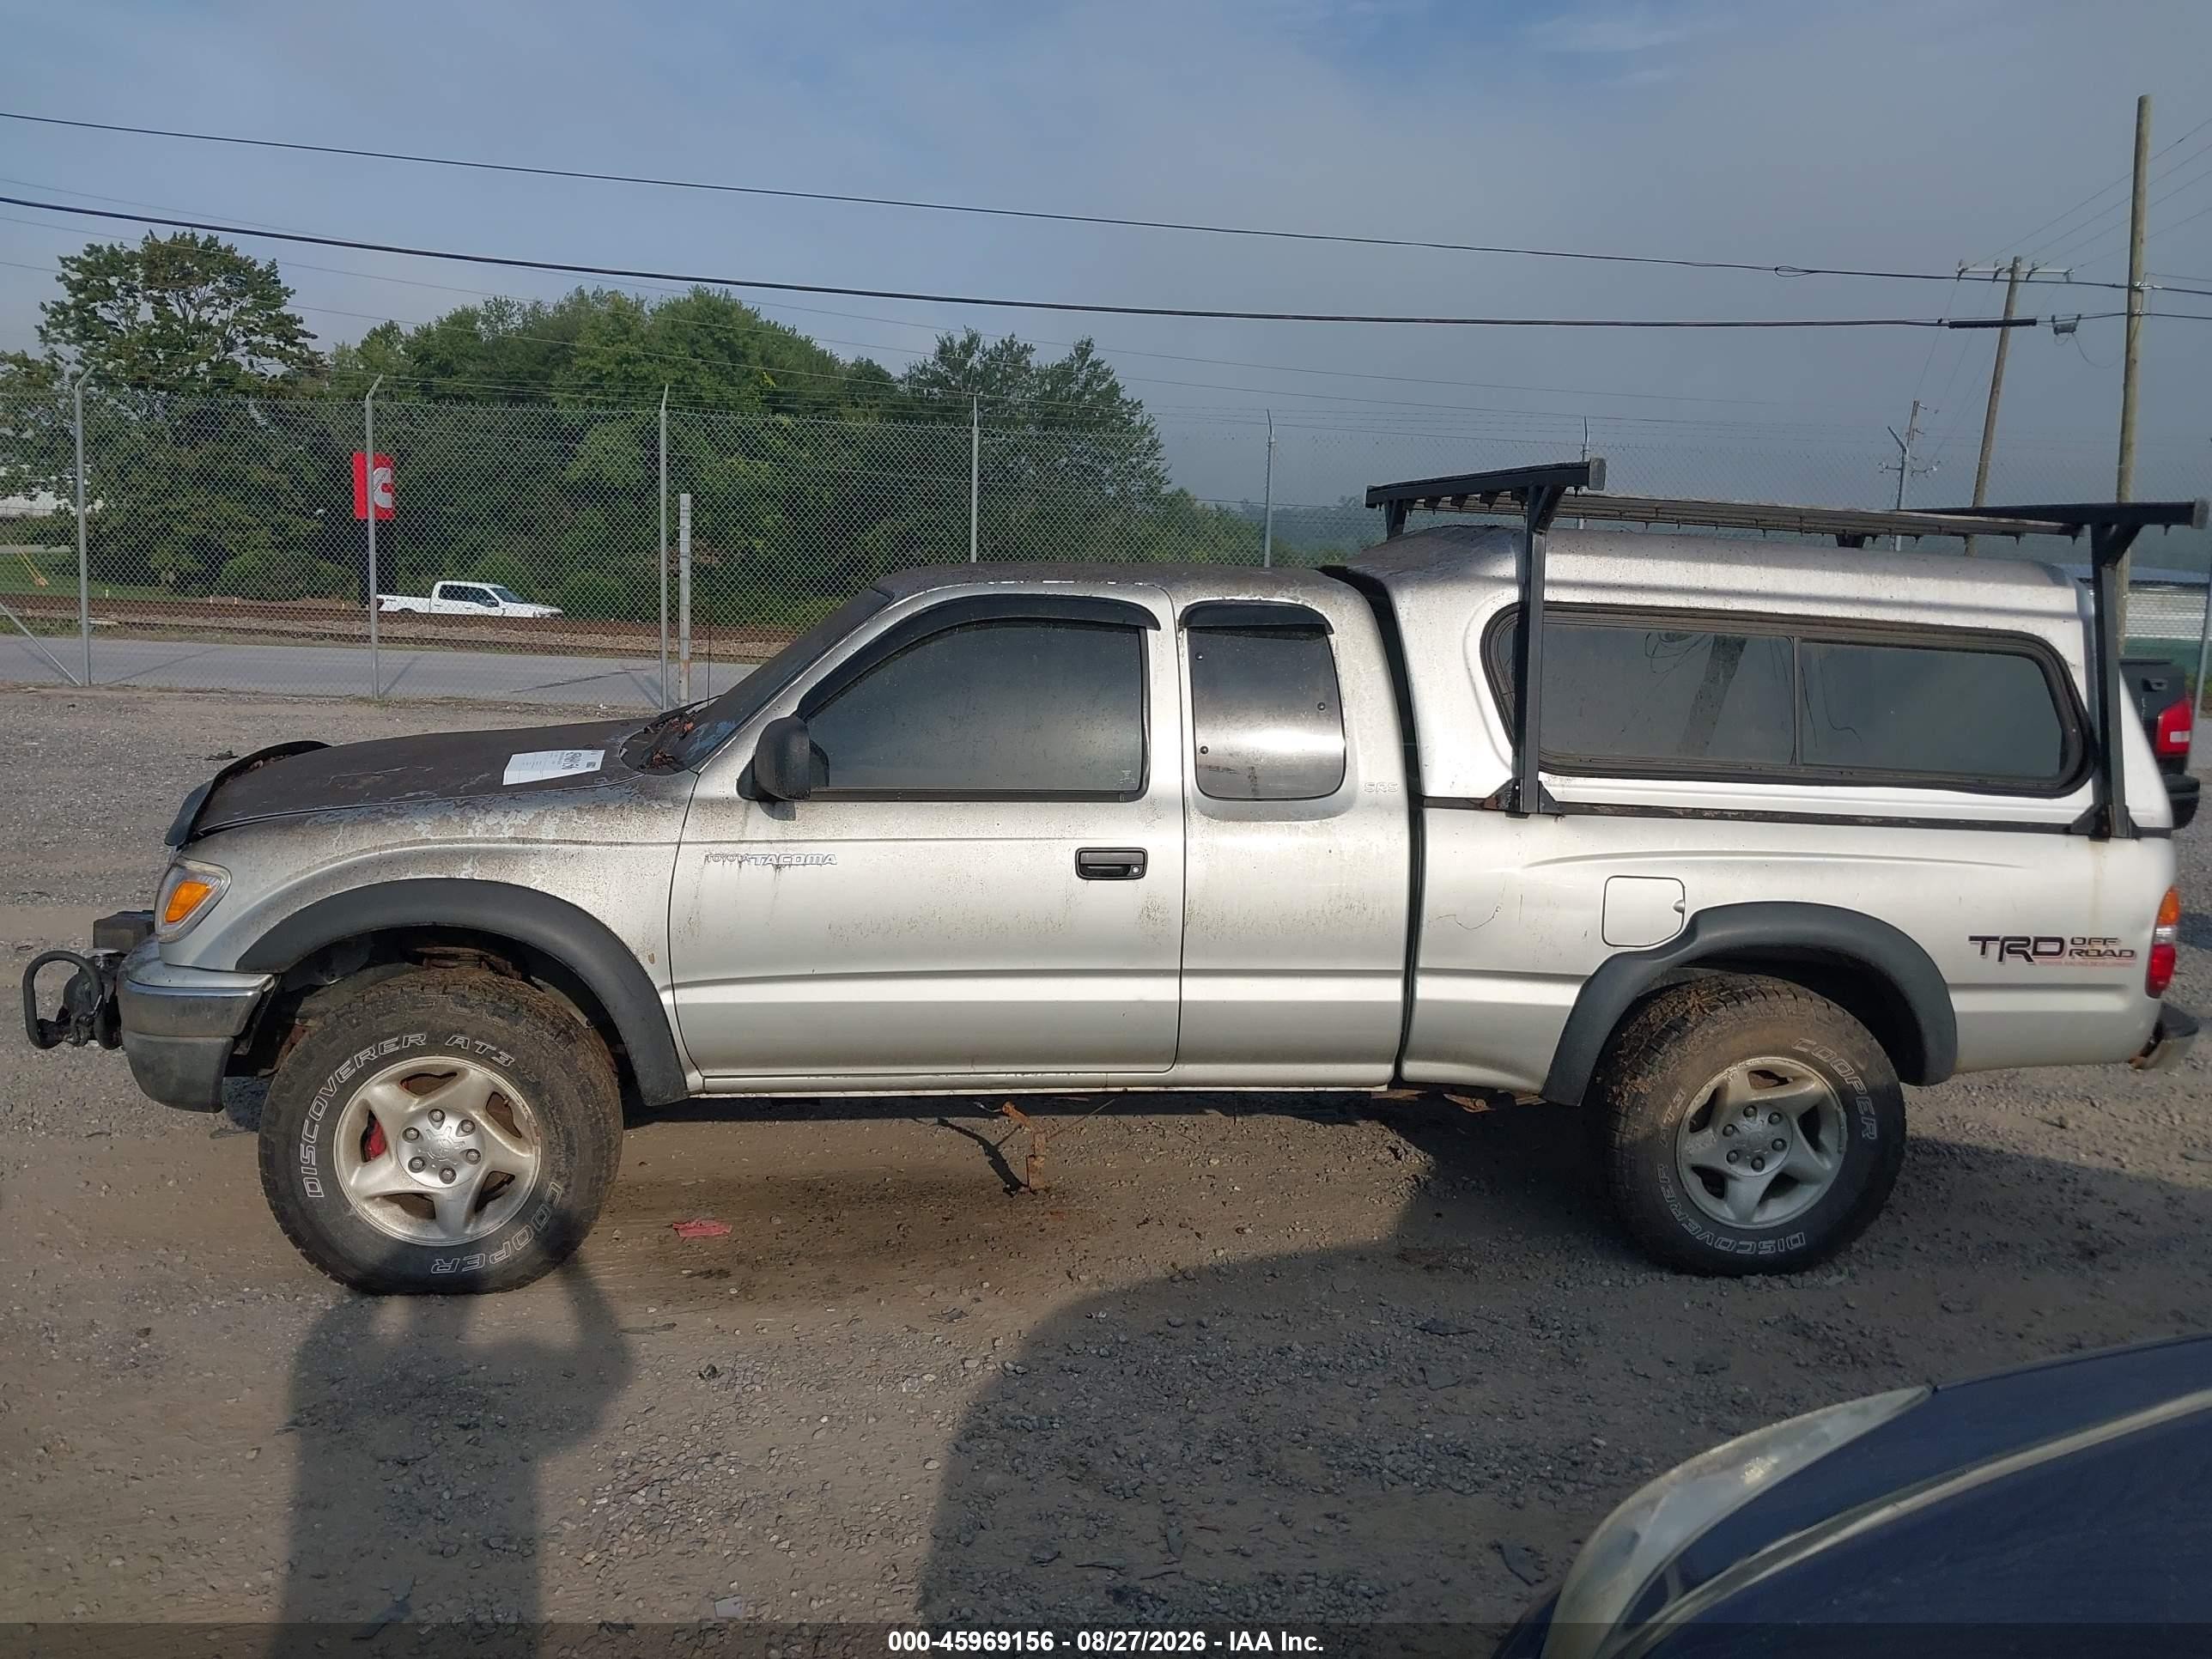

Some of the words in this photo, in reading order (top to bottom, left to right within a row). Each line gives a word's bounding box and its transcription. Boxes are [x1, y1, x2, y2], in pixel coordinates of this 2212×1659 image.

[1364, 781, 1399, 793] SRS
[705, 854, 750, 863] TOYOTA
[748, 854, 838, 866] TACOMA
[1968, 935, 2065, 963] TRD
[2069, 948, 2136, 958] ROAD
[2070, 937, 2120, 945] OFF
[1792, 1037, 1878, 1140] COOPER
[300, 1033, 427, 1199] DISCOVERER
[445, 1035, 515, 1067] AT3
[1656, 1163, 1806, 1255] DISCOVERER
[431, 1182, 562, 1274] COOPER
